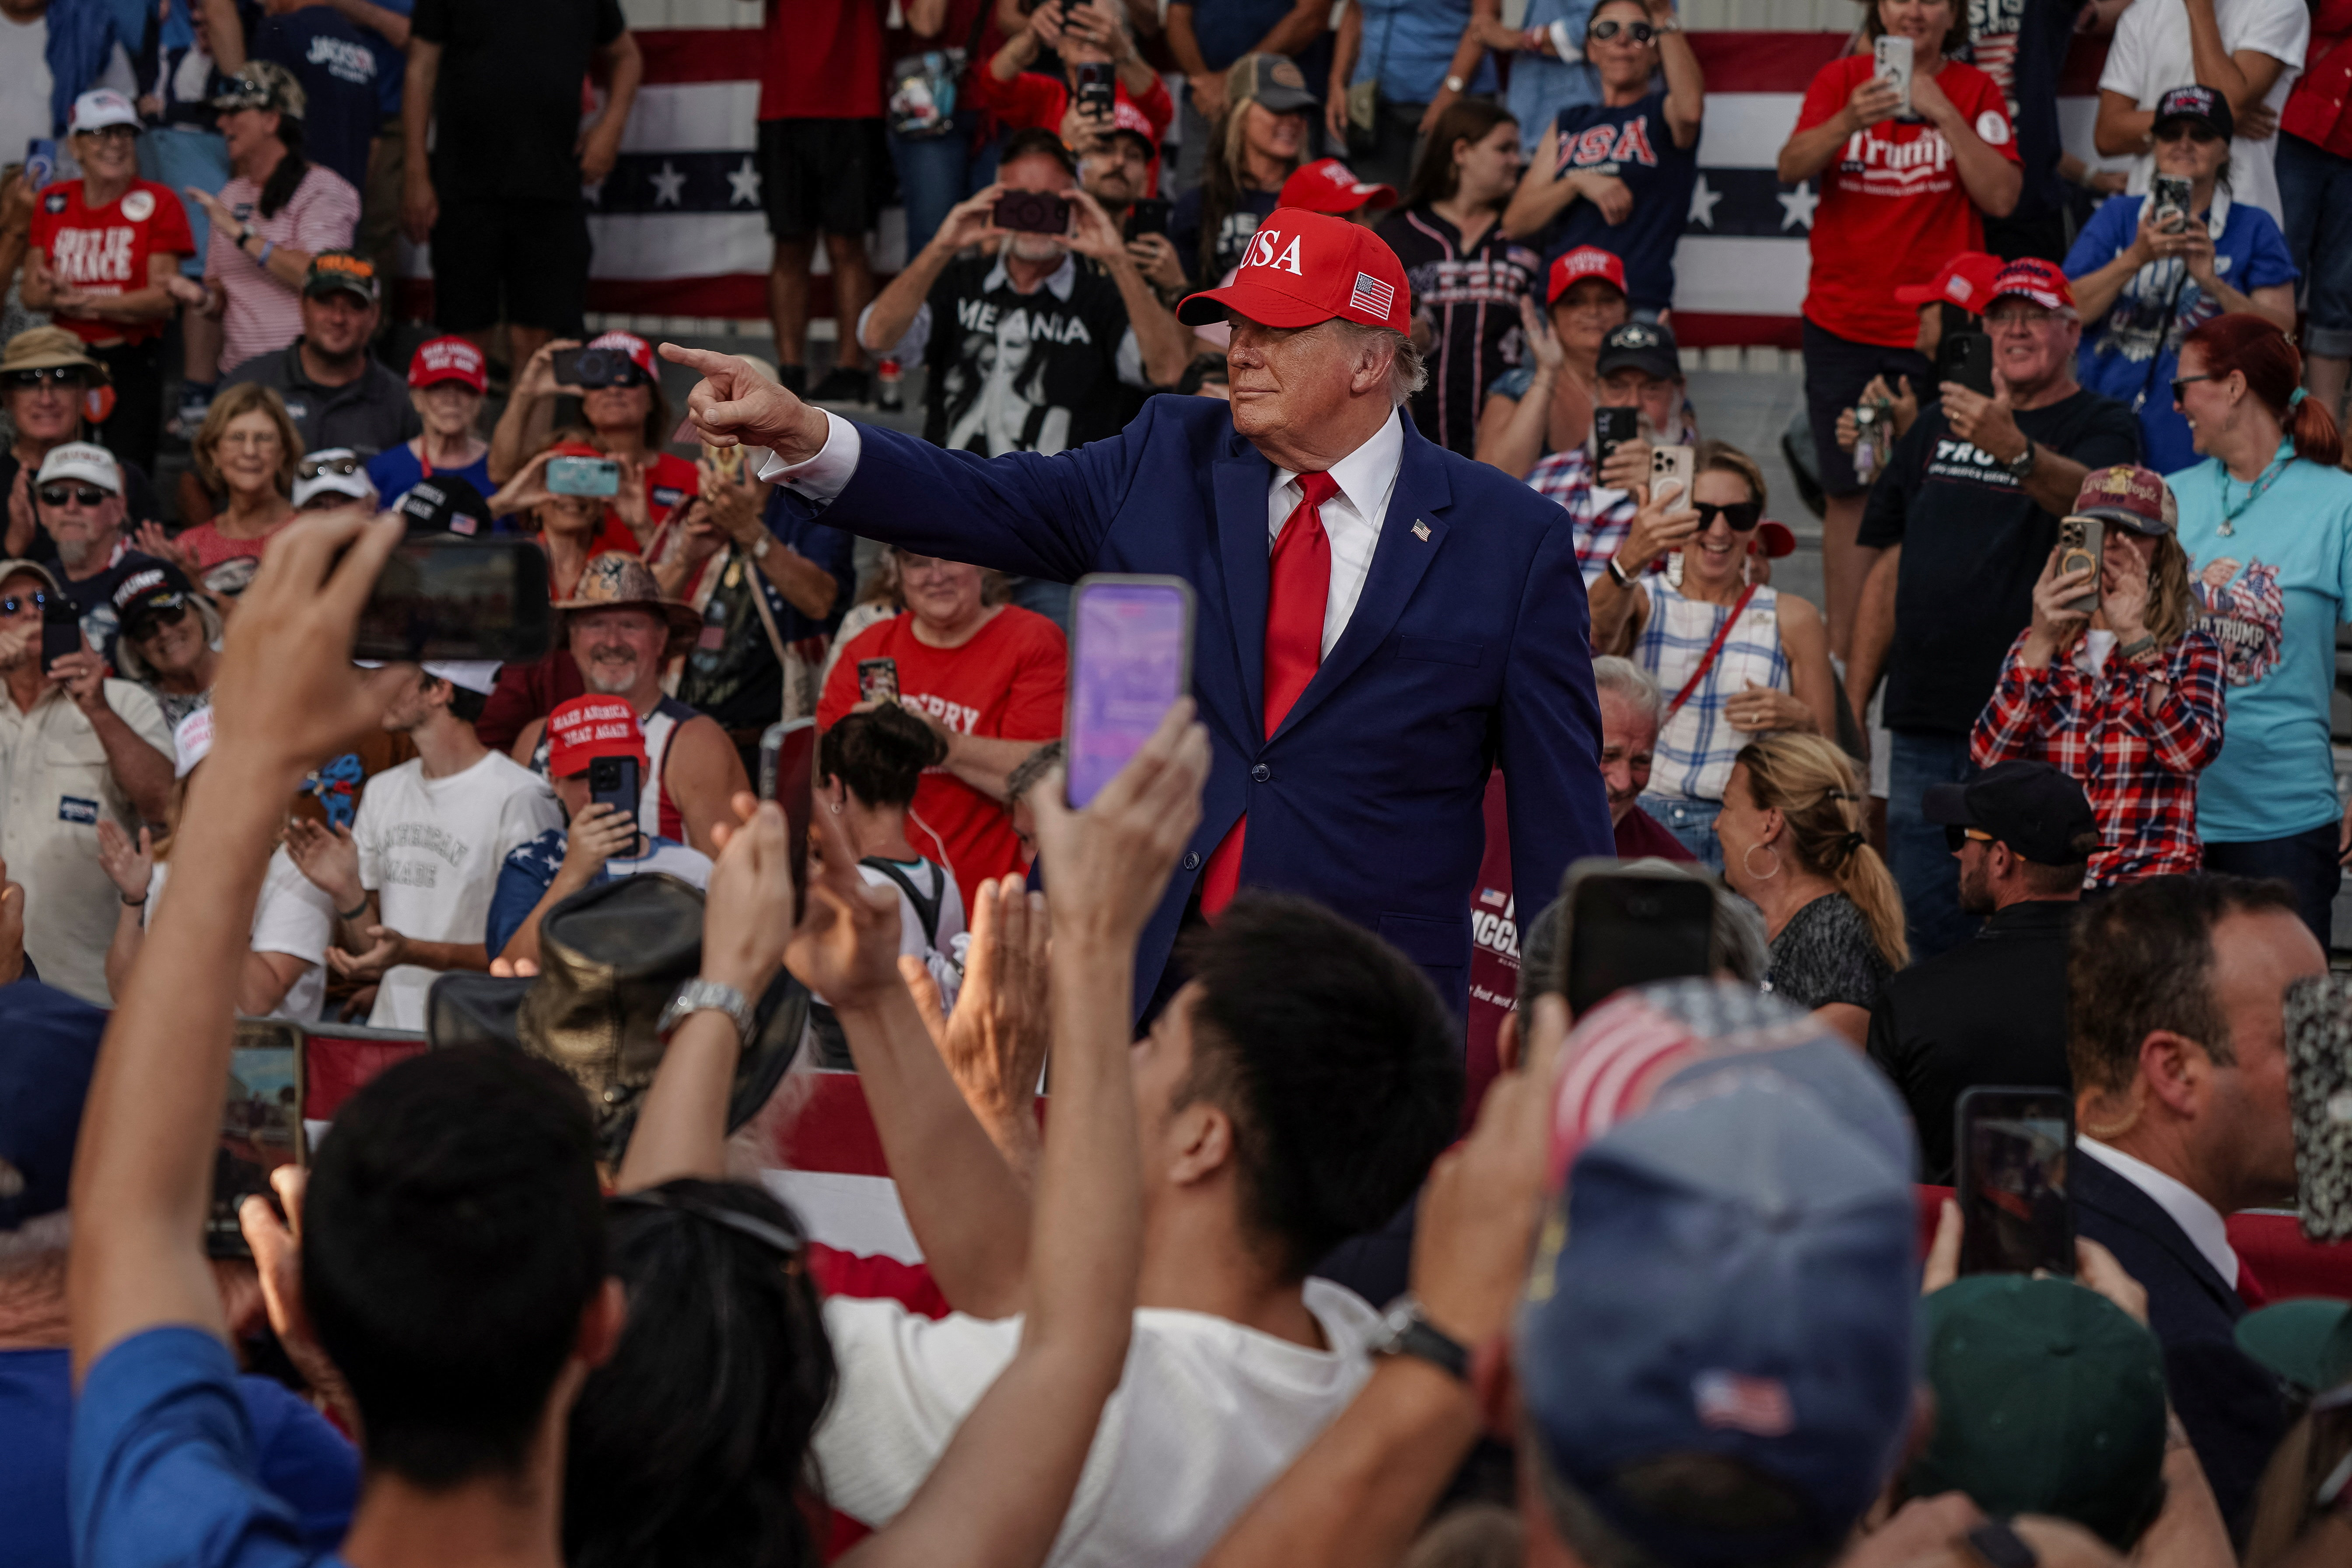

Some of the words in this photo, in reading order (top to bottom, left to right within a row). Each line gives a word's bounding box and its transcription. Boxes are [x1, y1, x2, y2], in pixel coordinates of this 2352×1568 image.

[1843, 126, 1954, 172] Trump
[1239, 230, 1303, 276] USA
[112, 569, 165, 609] TRUMP
[2213, 617, 2265, 650] TRUMP
[553, 709, 581, 732] MAKE
[583, 704, 631, 722] AMERICA
